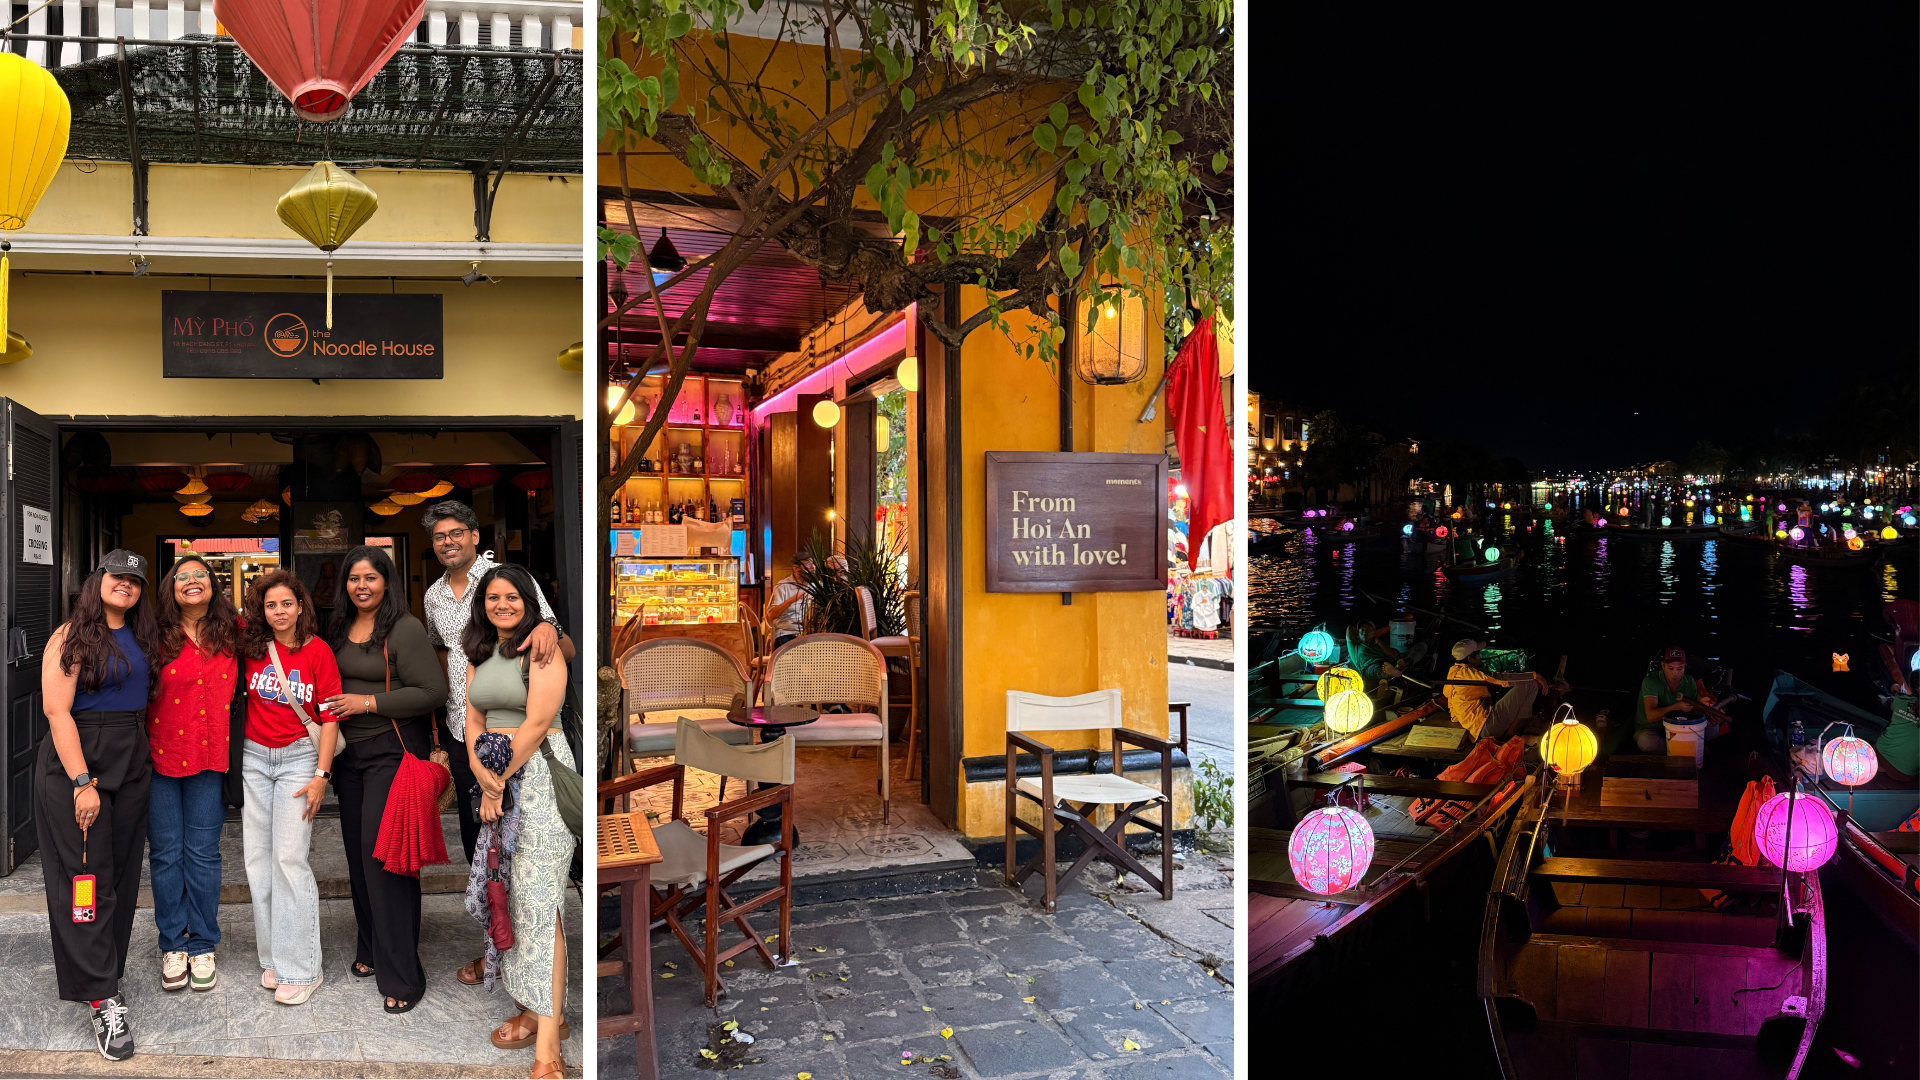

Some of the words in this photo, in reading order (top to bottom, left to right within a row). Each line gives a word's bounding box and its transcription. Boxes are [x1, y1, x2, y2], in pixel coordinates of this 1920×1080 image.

[312, 329, 331, 338] the
[313, 340, 377, 356] Noodle
[382, 340, 435, 356] House
[1012, 490, 1076, 513] From
[34, 524, 42, 534] NO
[1012, 517, 1052, 539] Hoi
[1058, 517, 1091, 539] An
[28, 538, 48, 550] CROSSING
[1012, 543, 1066, 566] with
[1072, 542, 1127, 566] love!
[250, 672, 313, 703] SKECERS
